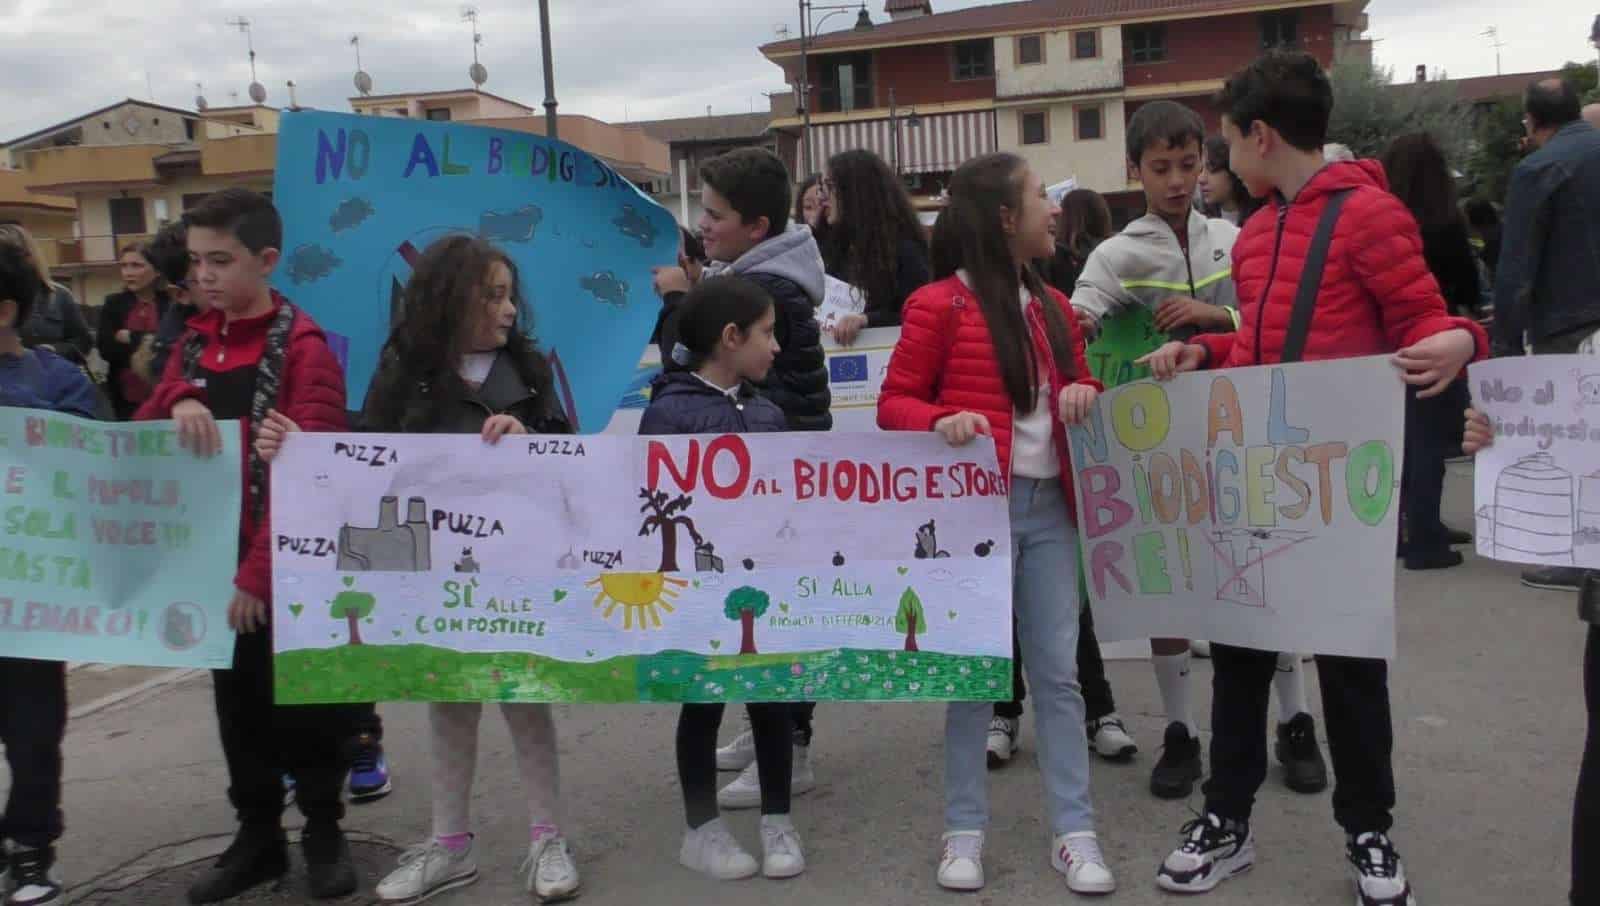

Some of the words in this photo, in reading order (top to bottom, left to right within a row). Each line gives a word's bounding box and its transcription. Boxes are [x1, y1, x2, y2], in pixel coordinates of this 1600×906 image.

[315, 128, 370, 184] NO
[401, 132, 471, 178] AL
[1480, 378, 1522, 403] No
[1067, 381, 1170, 470] NO
[335, 442, 398, 467] PUZZA
[528, 440, 586, 456] PUZZA
[5, 466, 25, 494] E
[647, 433, 751, 500] NO
[752, 478, 783, 496] AL
[793, 458, 1008, 503] BIODIGESTORE
[5, 506, 77, 540] SOLA
[432, 508, 505, 538] PUZZA
[278, 534, 336, 557] PUZZA
[583, 549, 623, 570] PUZZA
[1089, 527, 1194, 600] RE!
[831, 577, 873, 597] ALLA
[485, 597, 532, 614] ALLE
[415, 615, 546, 637] COMPOSTIERE
